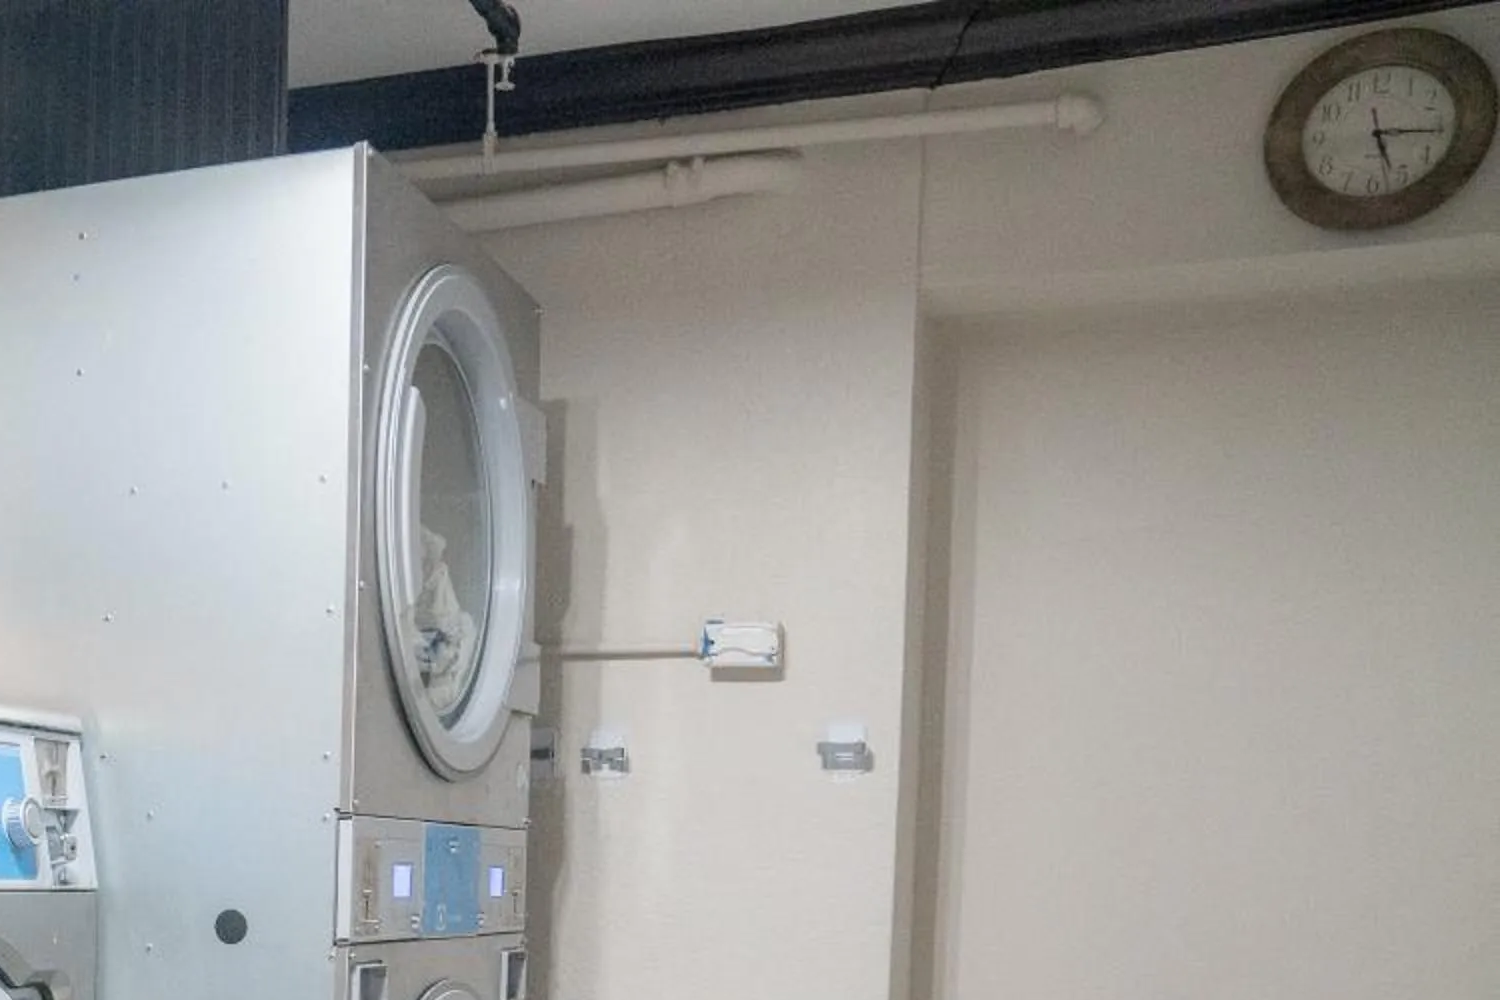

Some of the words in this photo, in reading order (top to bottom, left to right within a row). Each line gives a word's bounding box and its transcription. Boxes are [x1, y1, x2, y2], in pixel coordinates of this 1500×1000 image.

[1347, 79, 1361, 102] 11
[1372, 71, 1391, 94] 12
[1408, 75, 1414, 97] 1
[1424, 86, 1437, 111] 2
[1322, 103, 1341, 123] 10
[1367, 174, 1379, 194] 6
